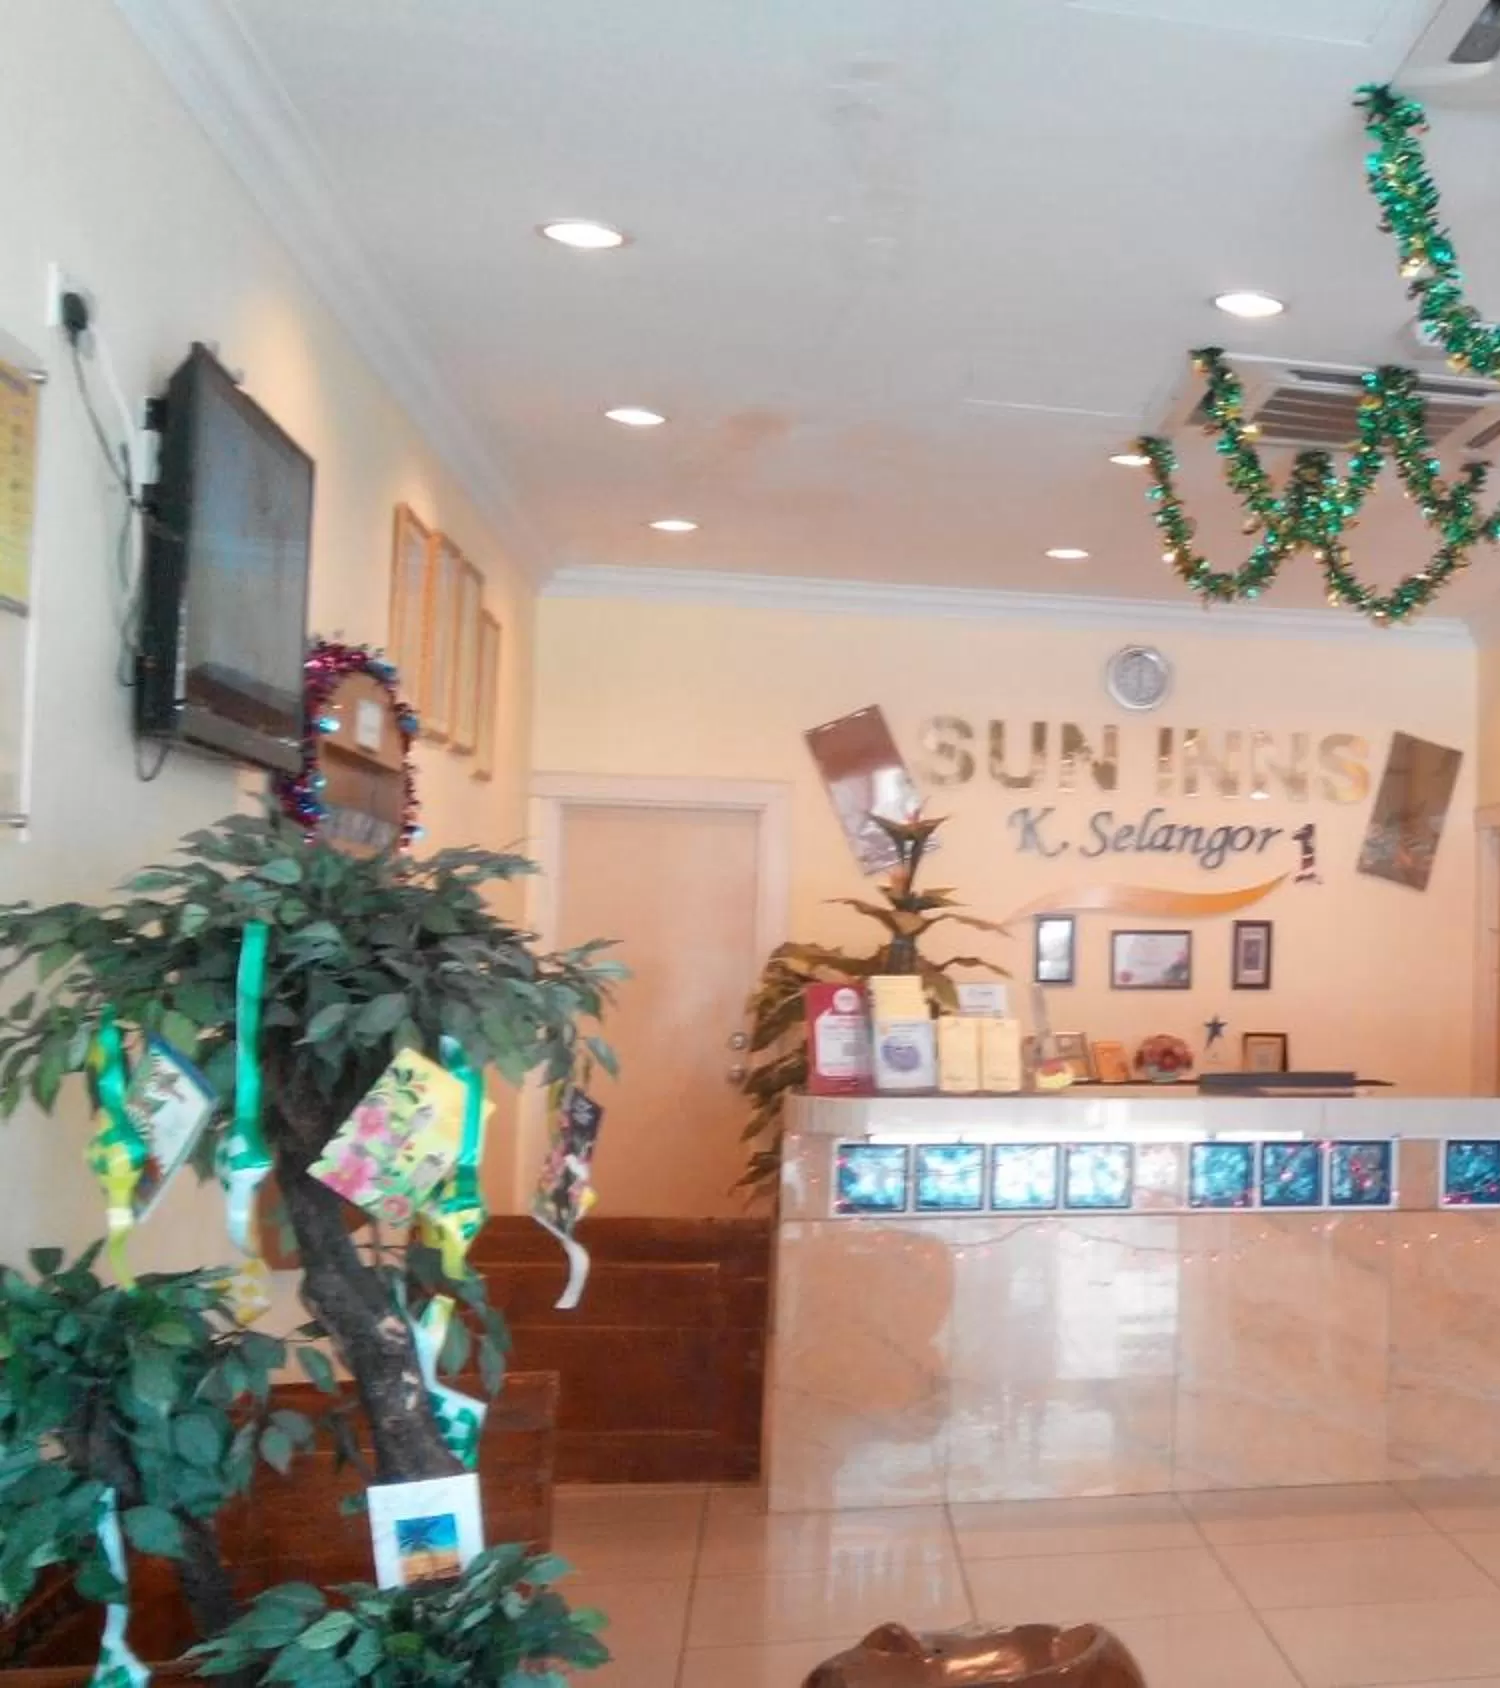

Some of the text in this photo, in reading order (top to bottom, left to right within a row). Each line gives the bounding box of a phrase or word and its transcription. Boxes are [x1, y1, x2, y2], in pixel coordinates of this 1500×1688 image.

[916, 714, 1371, 803] SUN INNS
[1006, 806, 1323, 885] K. Selangor 1
